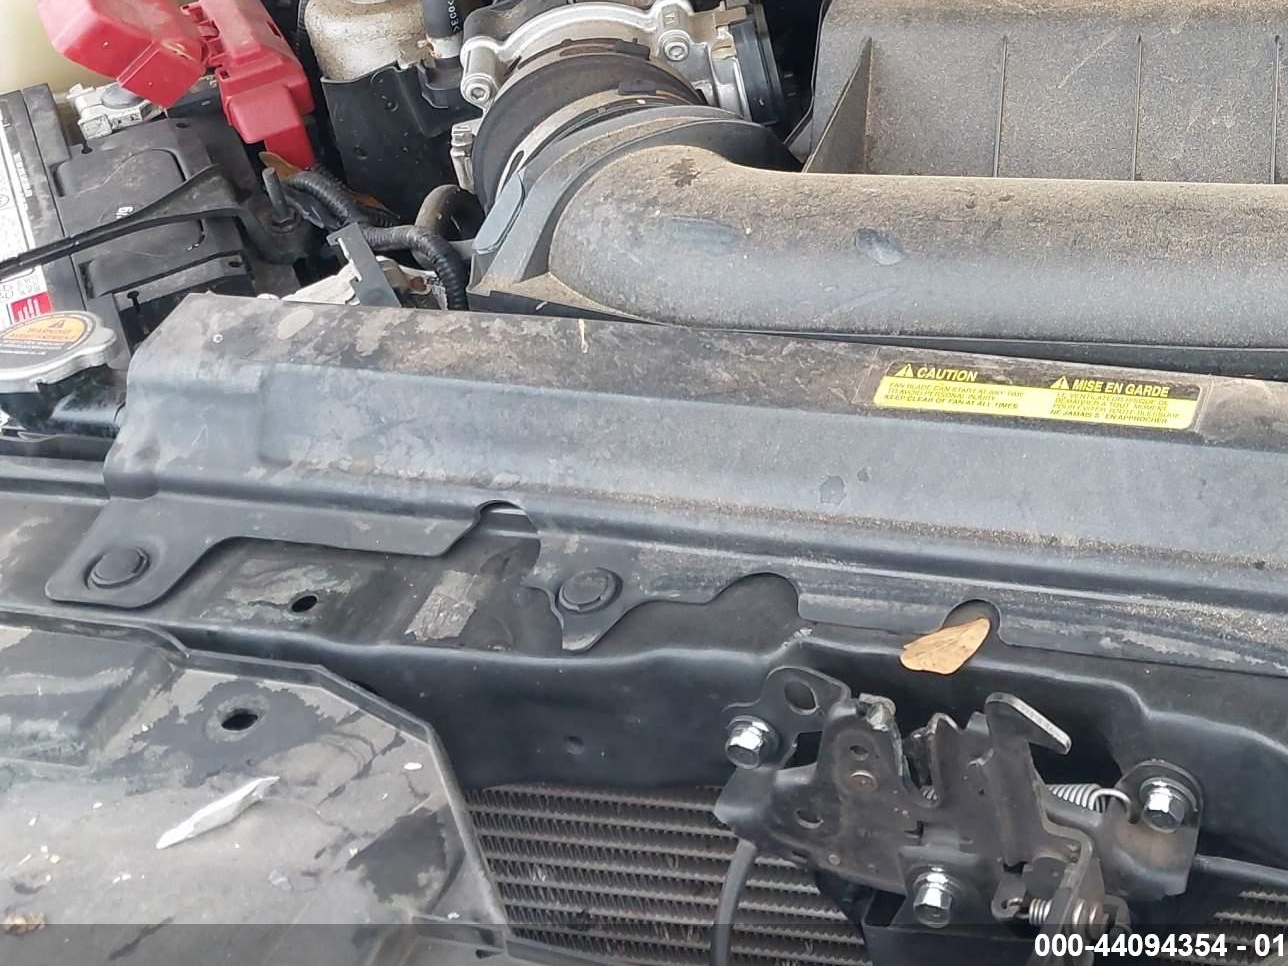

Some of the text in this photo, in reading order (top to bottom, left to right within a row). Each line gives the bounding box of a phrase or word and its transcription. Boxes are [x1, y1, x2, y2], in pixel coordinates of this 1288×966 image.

[917, 366, 978, 382] CAUTION
[1072, 378, 1170, 398] MISE EN GARDE
